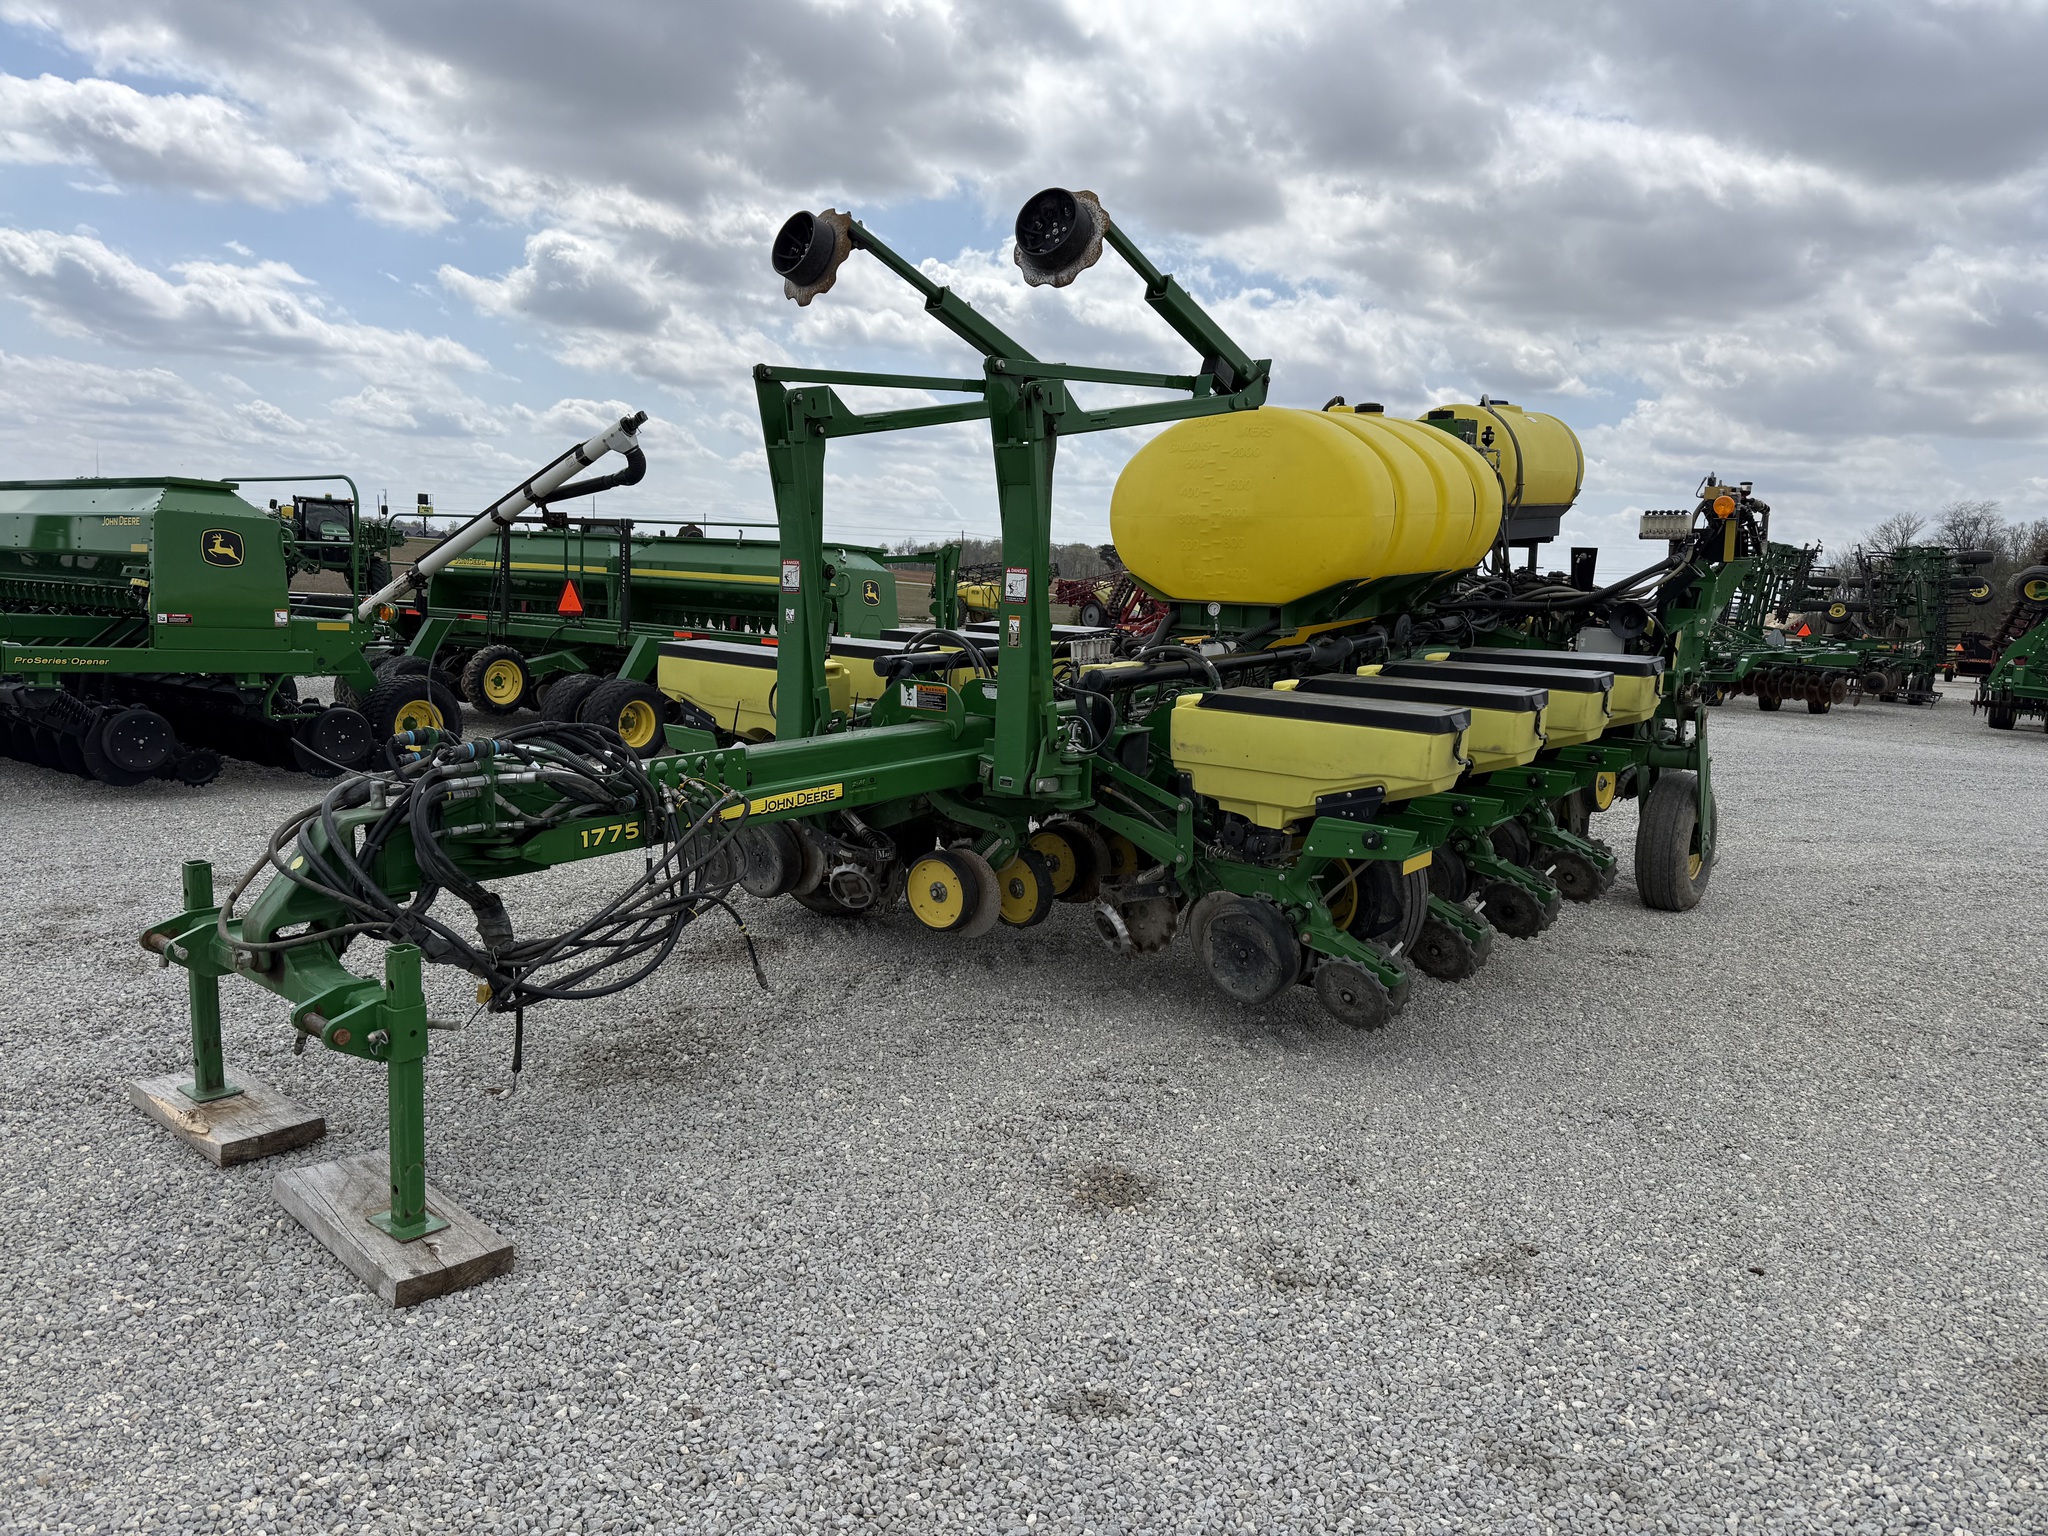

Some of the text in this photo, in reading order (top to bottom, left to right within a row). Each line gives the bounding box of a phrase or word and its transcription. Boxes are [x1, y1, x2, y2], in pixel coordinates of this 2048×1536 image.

[102, 516, 140, 526] JOHN DEERE
[14, 656, 110, 666] ProSeries Opener
[760, 788, 836, 814] JOHN DEERE
[581, 821, 640, 848] 1775
